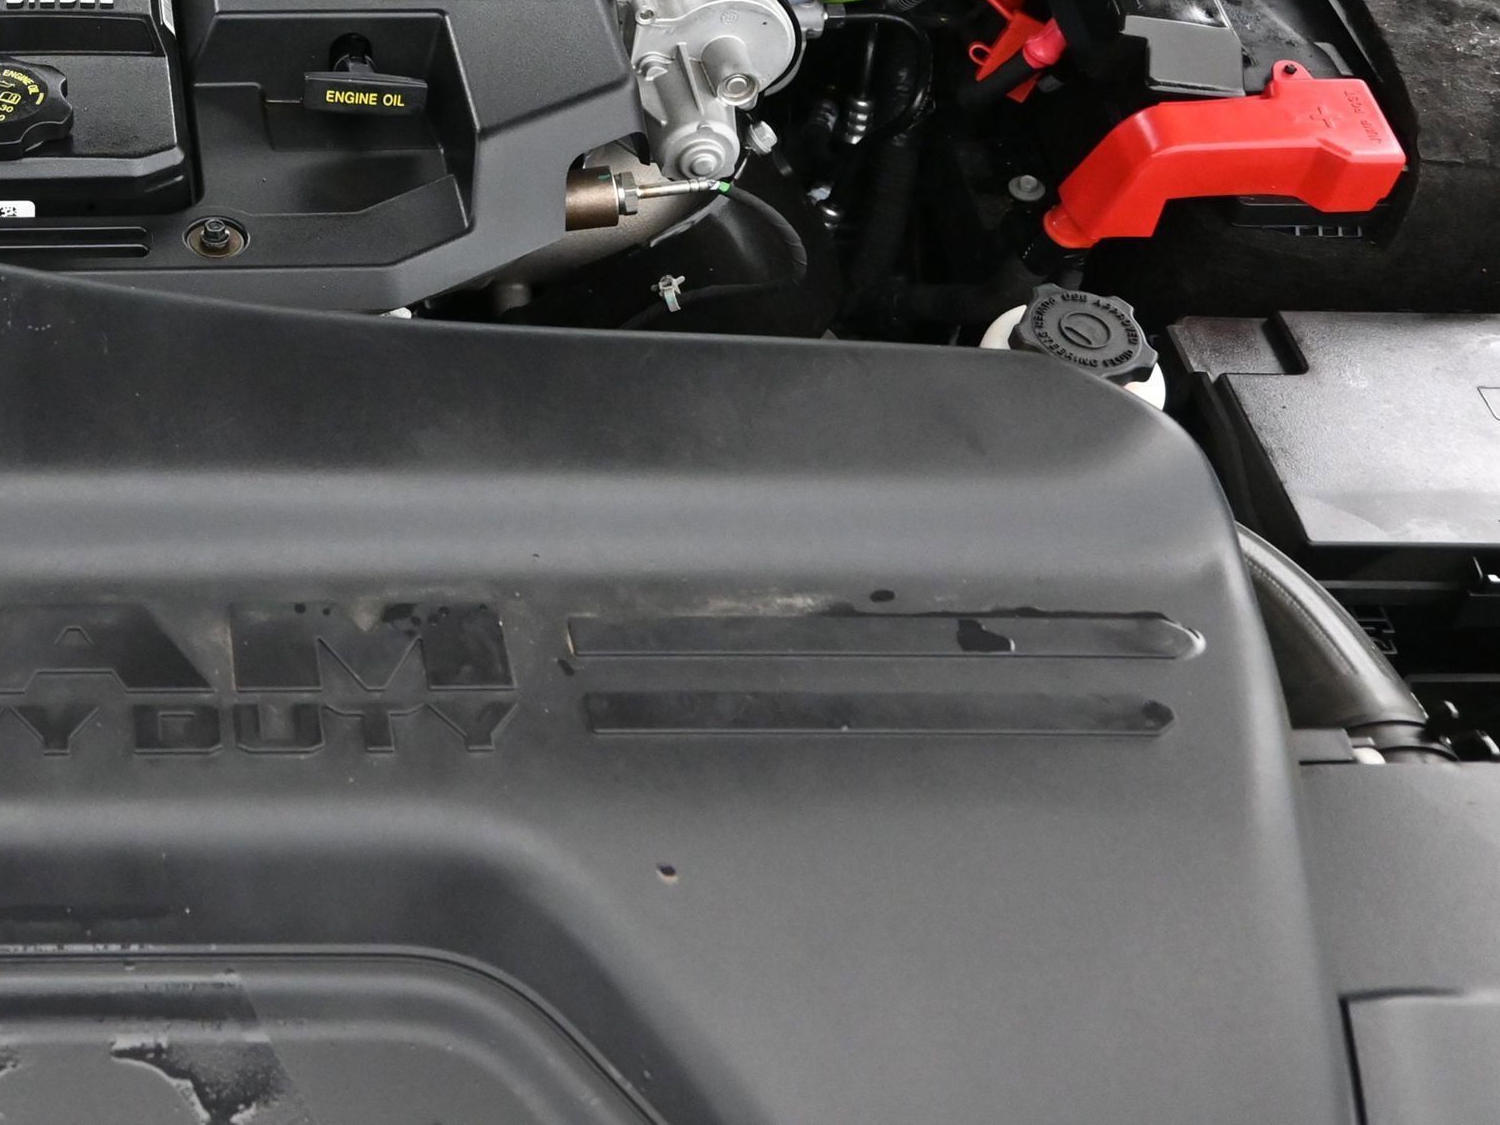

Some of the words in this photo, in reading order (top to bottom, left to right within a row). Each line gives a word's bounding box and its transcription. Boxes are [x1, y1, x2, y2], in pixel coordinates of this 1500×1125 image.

[2, 69, 35, 87] ENGINE
[325, 90, 378, 106] ENGINE
[382, 93, 405, 107] OIL
[132, 702, 518, 755] DUTY
